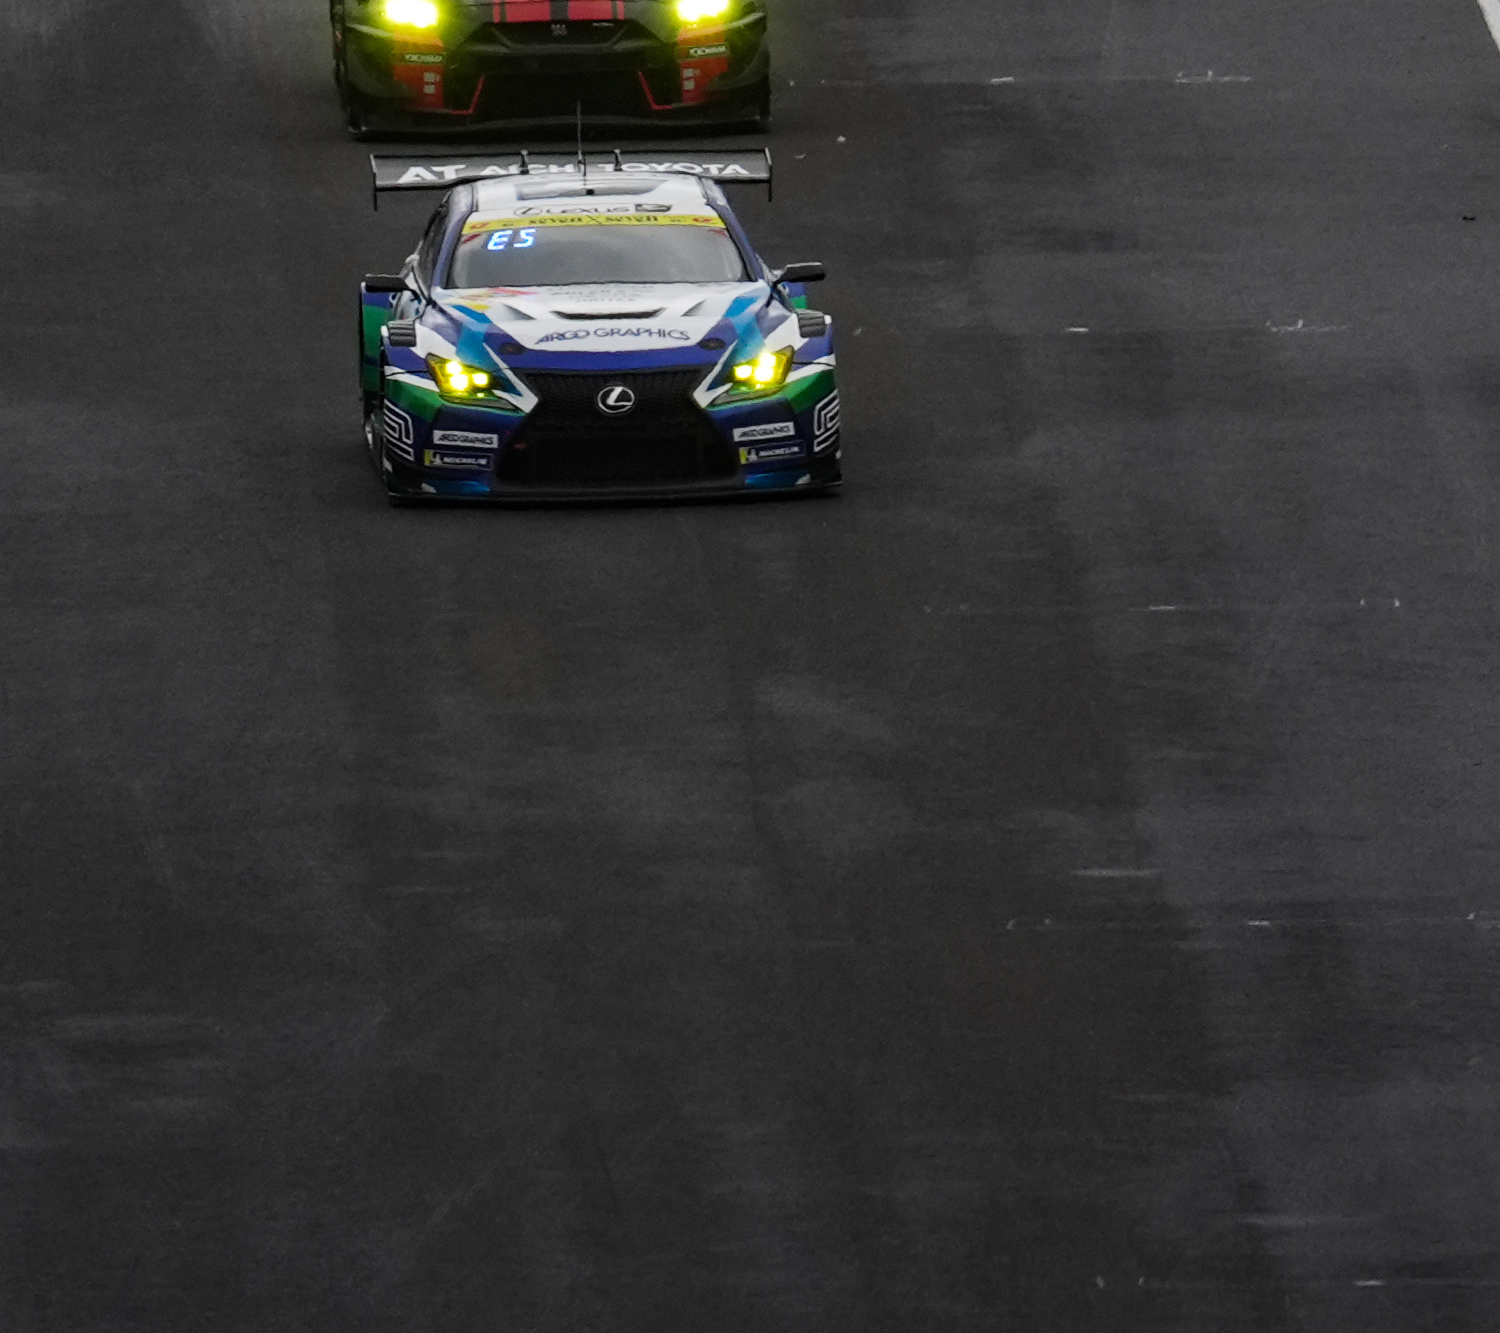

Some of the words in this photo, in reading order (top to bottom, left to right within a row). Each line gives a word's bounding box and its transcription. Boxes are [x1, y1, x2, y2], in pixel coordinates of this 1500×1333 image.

[396, 163, 467, 185] AT
[597, 161, 752, 176] TOYOTA
[545, 205, 630, 215] LEXUS
[533, 329, 590, 345] ARGO
[593, 327, 692, 342] GRAPHICS
